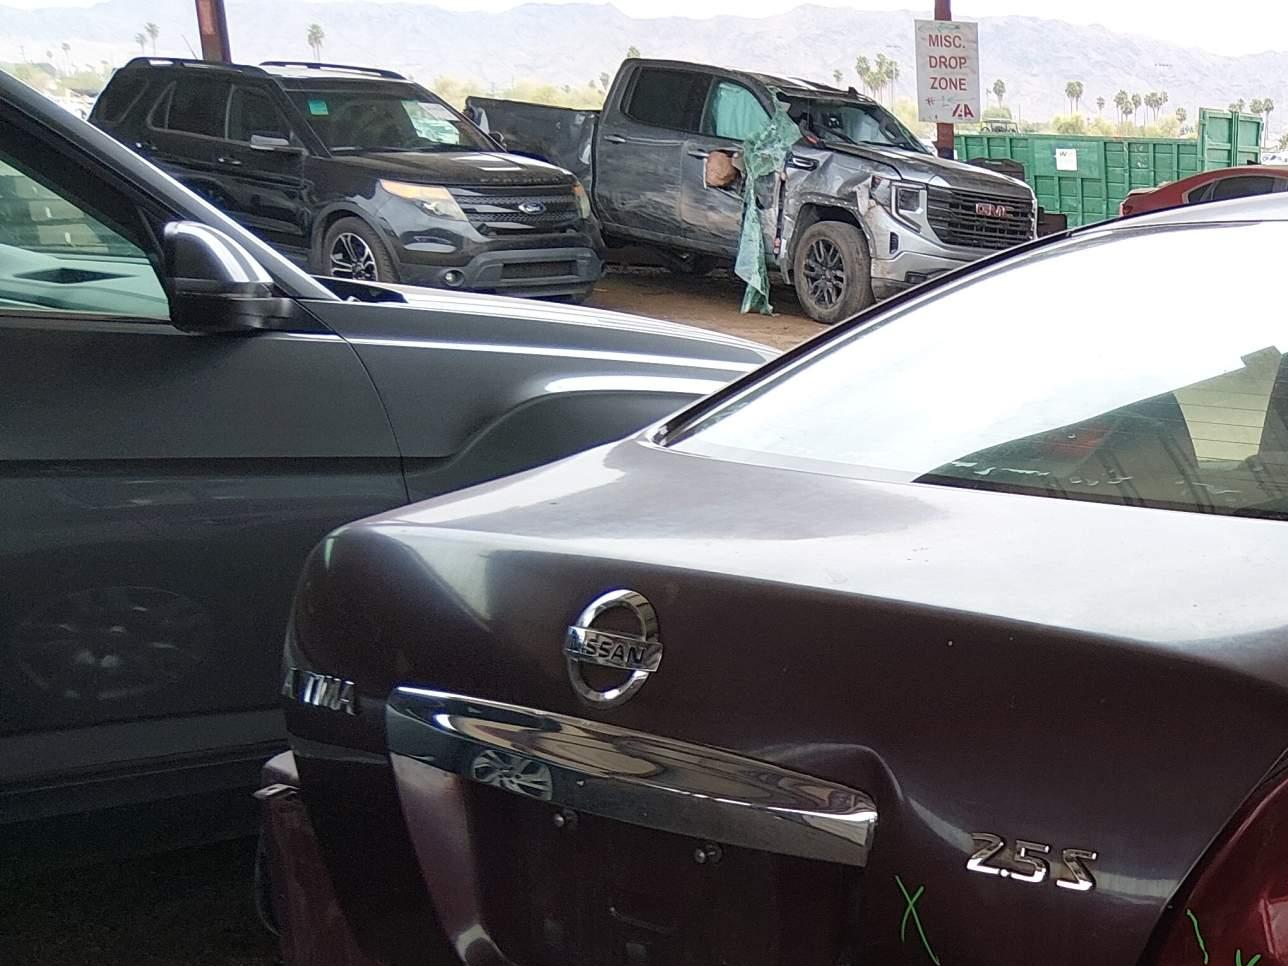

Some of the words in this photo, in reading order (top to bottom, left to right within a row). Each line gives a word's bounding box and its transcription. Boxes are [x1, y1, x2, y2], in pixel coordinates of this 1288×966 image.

[928, 35, 966, 49] MISC.
[928, 55, 968, 70] DROP
[929, 77, 968, 91] ZONE
